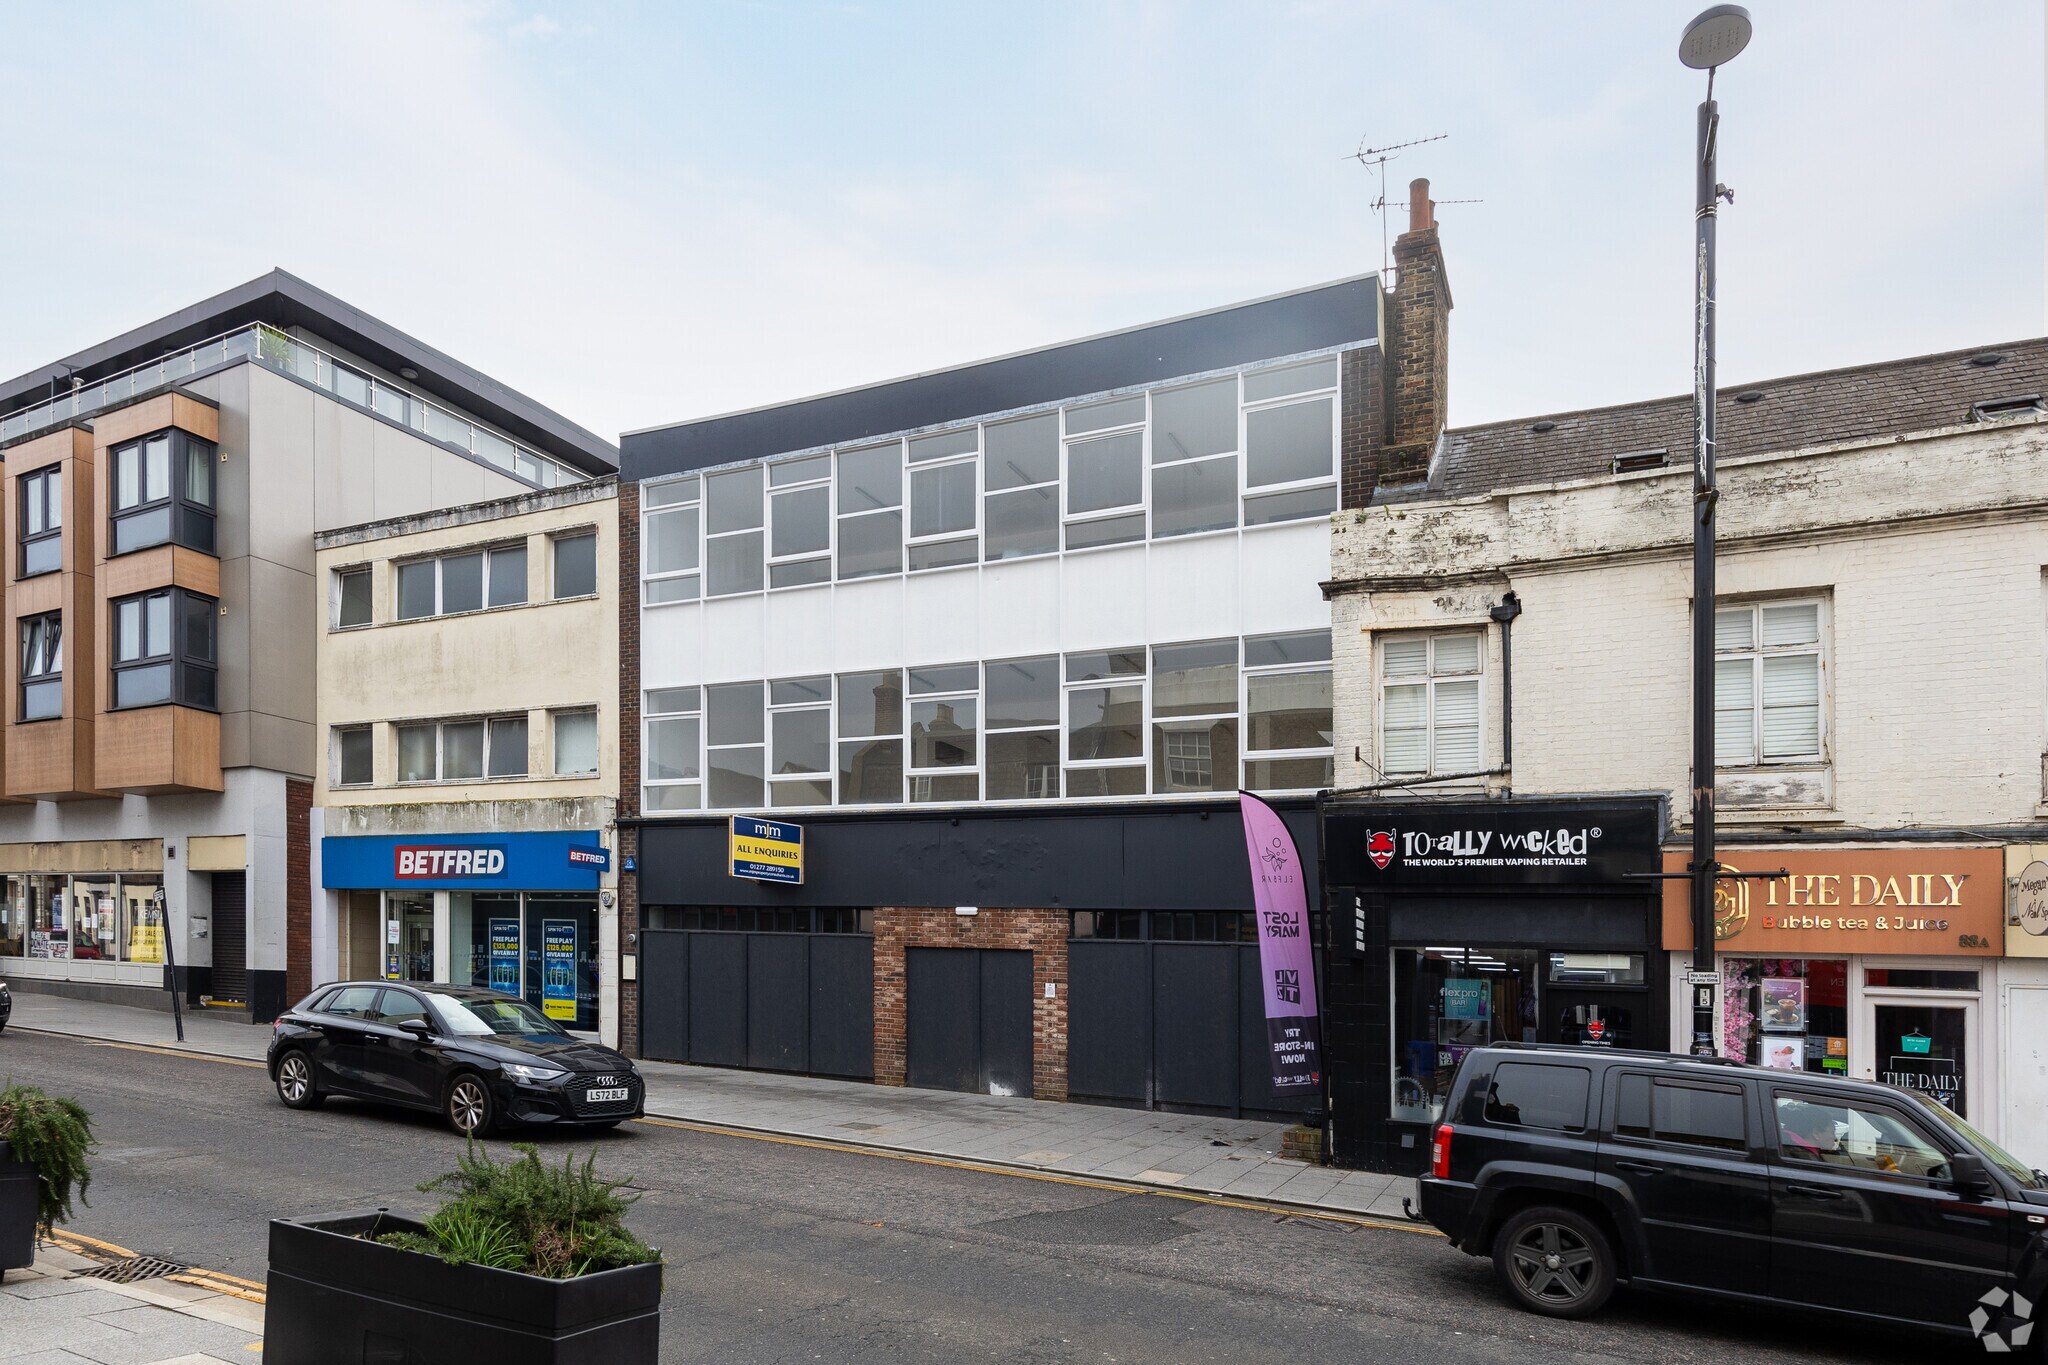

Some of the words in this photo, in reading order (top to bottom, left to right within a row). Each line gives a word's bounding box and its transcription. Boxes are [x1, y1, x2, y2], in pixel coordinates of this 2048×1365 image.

[570, 851, 606, 864] BETFRED
[737, 844, 752, 854] ALL
[754, 846, 798, 860] ENQUIRIES
[399, 849, 505, 875] BETFRED
[749, 863, 766, 871] 01277
[1422, 858, 1463, 866] WORLD'S
[1464, 858, 1504, 866] PREMIER
[1505, 858, 1540, 866] VAPING
[1541, 857, 1587, 866] RETAILER
[1758, 872, 1840, 906] THE
[1850, 874, 1971, 906] DAILY
[2021, 899, 2044, 919] Nail
[1762, 915, 1832, 930] Bubble
[1838, 917, 1869, 930] tea
[1875, 916, 1889, 930] &
[1893, 915, 1949, 931] Juice
[1882, 1071, 1915, 1088] THE
[1918, 1073, 1962, 1091] DAILY
[590, 1090, 610, 1101] LS72
[611, 1089, 626, 1100] BLF
